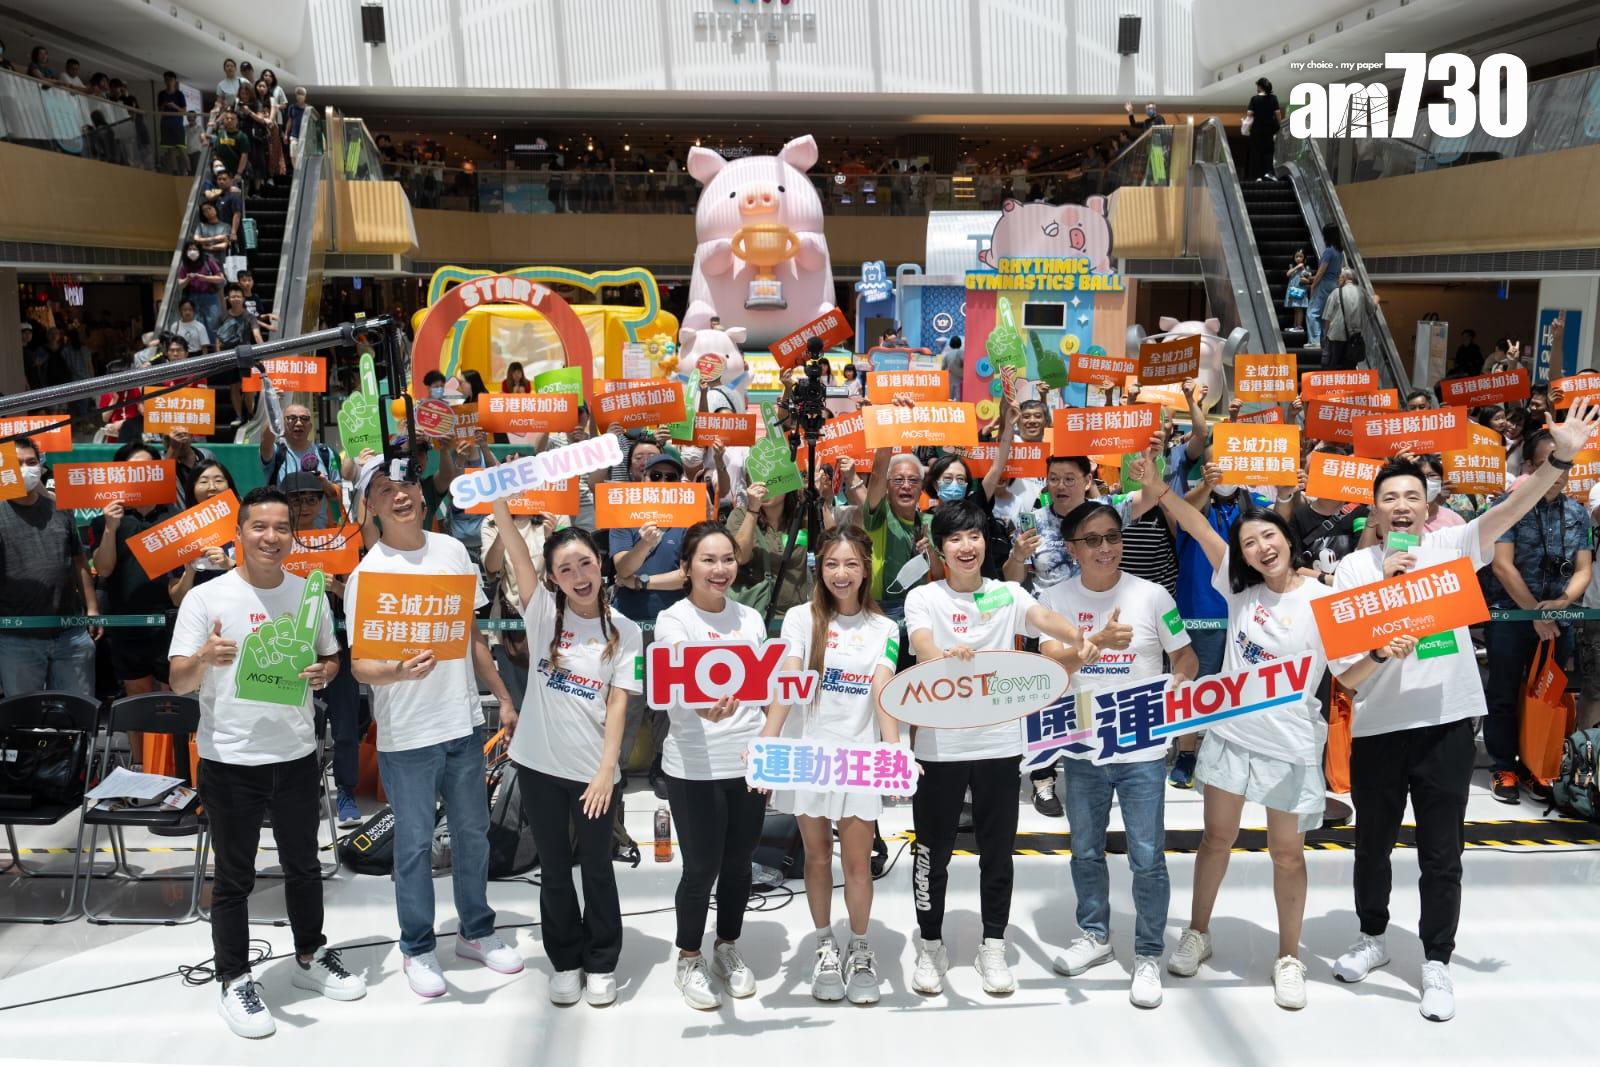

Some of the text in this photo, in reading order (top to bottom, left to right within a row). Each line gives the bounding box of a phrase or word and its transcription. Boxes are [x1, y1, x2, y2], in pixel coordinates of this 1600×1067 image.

[999, 257, 1089, 274] RHYTHMIC
[459, 276, 551, 308] START
[965, 274, 1122, 290] GYMNASTICS BALL
[1078, 357, 1135, 373] 香港隊加油
[875, 374, 941, 387] 香港隊加油
[1310, 372, 1370, 387] 香港隊加油
[1450, 373, 1519, 395] 香港隊加油
[489, 397, 568, 413] 香港隊加油
[601, 389, 675, 413] 香港隊加油
[875, 406, 966, 425] 香港隊加油
[1067, 409, 1153, 431] 香港隊加油
[1365, 412, 1456, 437] 香港隊加油
[1227, 436, 1288, 453] 全城力撐
[456, 439, 618, 503] SURE WIN!
[1218, 455, 1295, 472] 香港運動員
[68, 465, 164, 486] 香港隊加油
[607, 487, 696, 505] 香港隊加油
[142, 499, 231, 553] 香港隊加油
[376, 592, 462, 616] 全城力撐
[1330, 568, 1461, 624] 香港隊加油
[304, 595, 320, 629] 1
[362, 619, 466, 643] 香港運動員
[652, 644, 814, 705] HOY TV
[1080, 666, 1130, 675] HONG KONG
[1258, 656, 1313, 699] TV
[546, 681, 596, 701] HONG KONG
[844, 686, 869, 695] KONG
[752, 744, 912, 790] 運動狂熱
